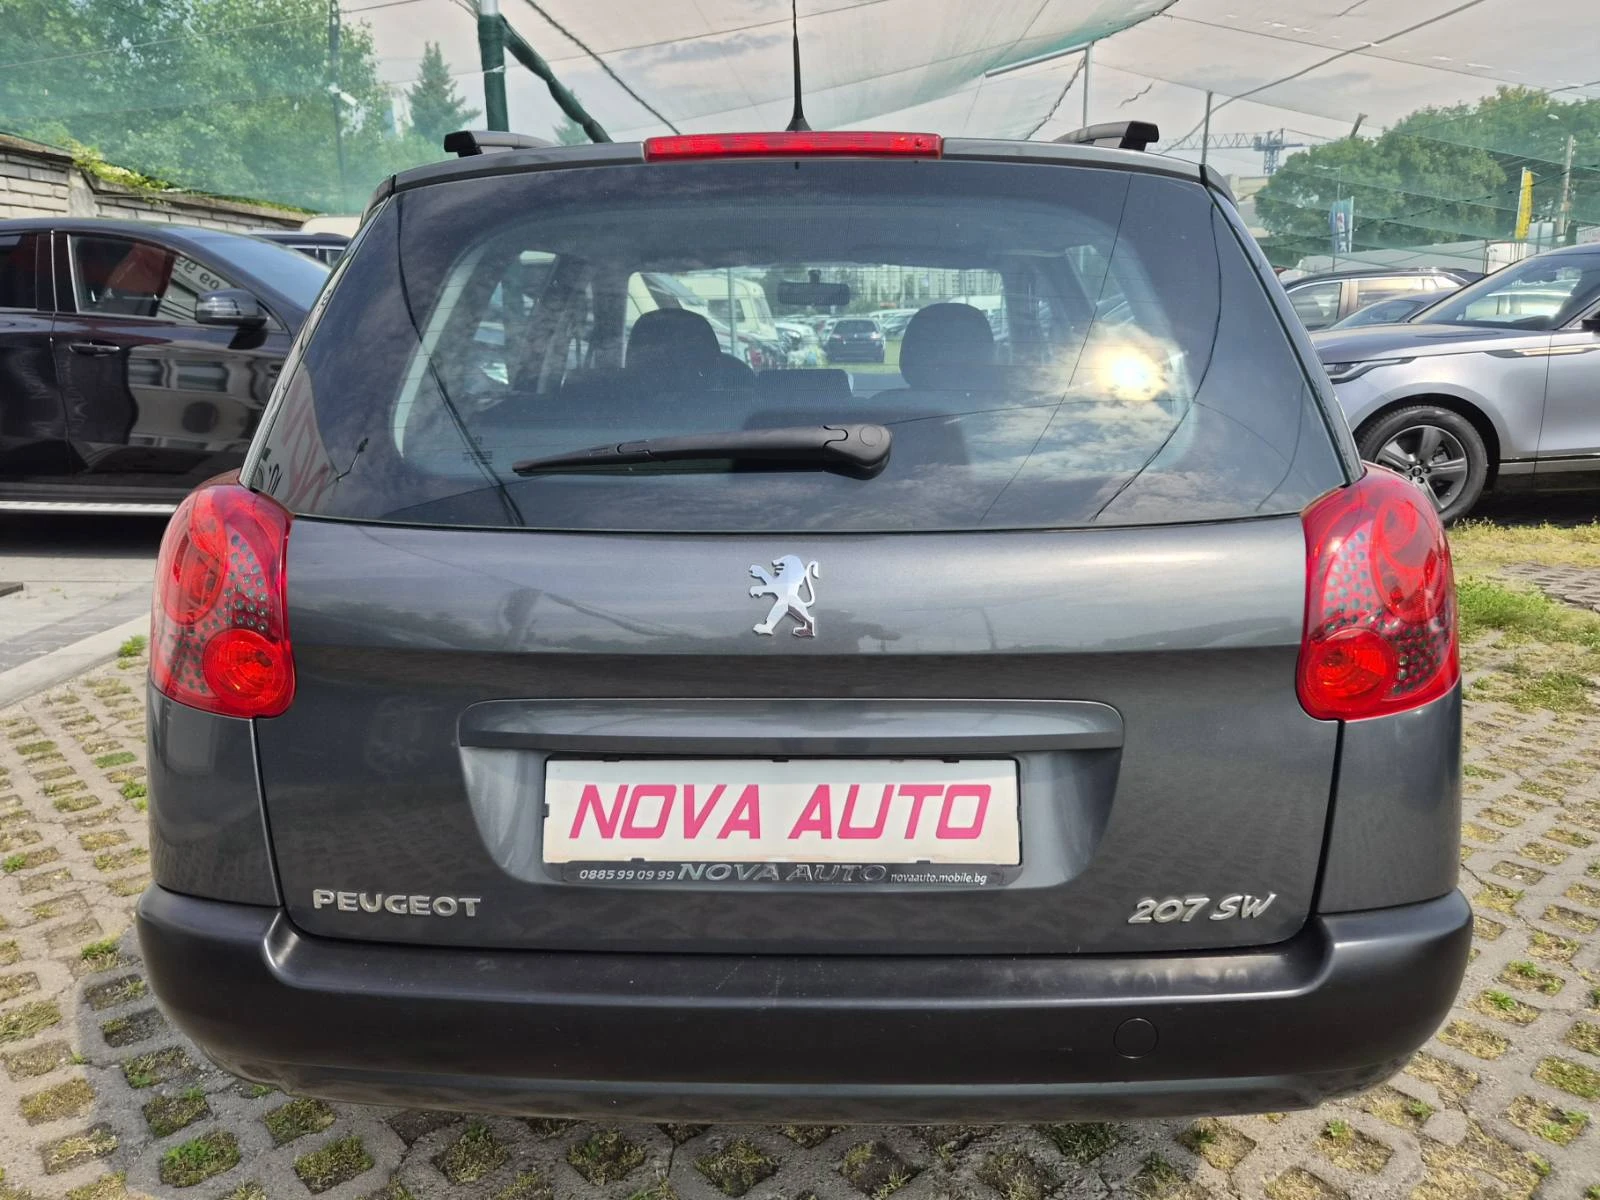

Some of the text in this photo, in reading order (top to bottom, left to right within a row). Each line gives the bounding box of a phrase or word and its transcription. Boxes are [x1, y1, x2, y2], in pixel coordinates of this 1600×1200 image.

[568, 784, 992, 839] NOVA AUTO
[579, 863, 988, 886] 0885 99 09 99 NOVA AUTO novaauto.mobile.bg
[312, 888, 481, 917] PEUGEOT
[1127, 892, 1277, 924] 207 SW
